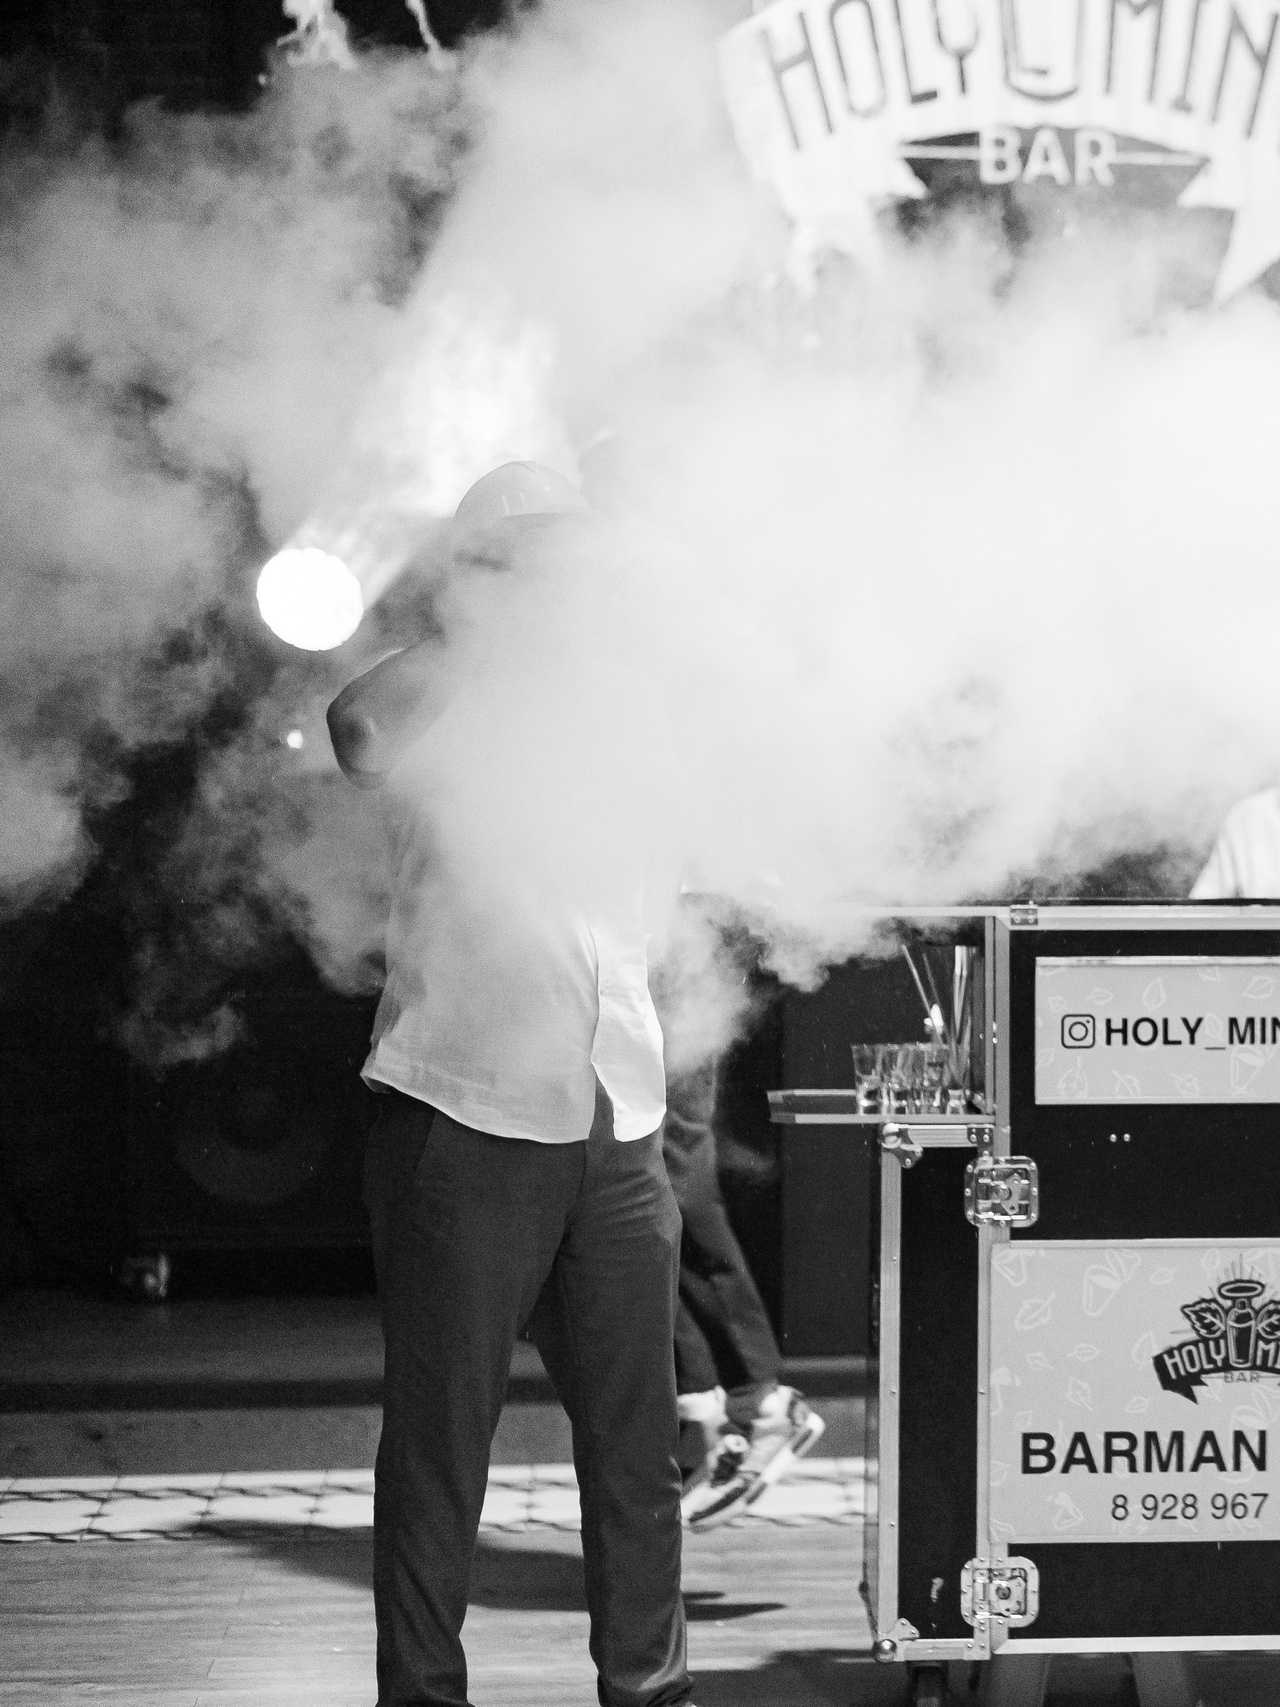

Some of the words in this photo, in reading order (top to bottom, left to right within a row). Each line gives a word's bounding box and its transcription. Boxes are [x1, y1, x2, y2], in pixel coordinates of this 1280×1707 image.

[757, 0, 980, 152] HOLY
[978, 128, 1117, 186] BAR
[1162, 1338, 1226, 1380] HOLY
[1223, 1371, 1260, 1383] BAR
[1021, 1430, 1268, 1474] BARMAN
[1111, 1494, 1129, 1521] 8
[1140, 1493, 1199, 1520] 928
[1210, 1493, 1269, 1520] 967
